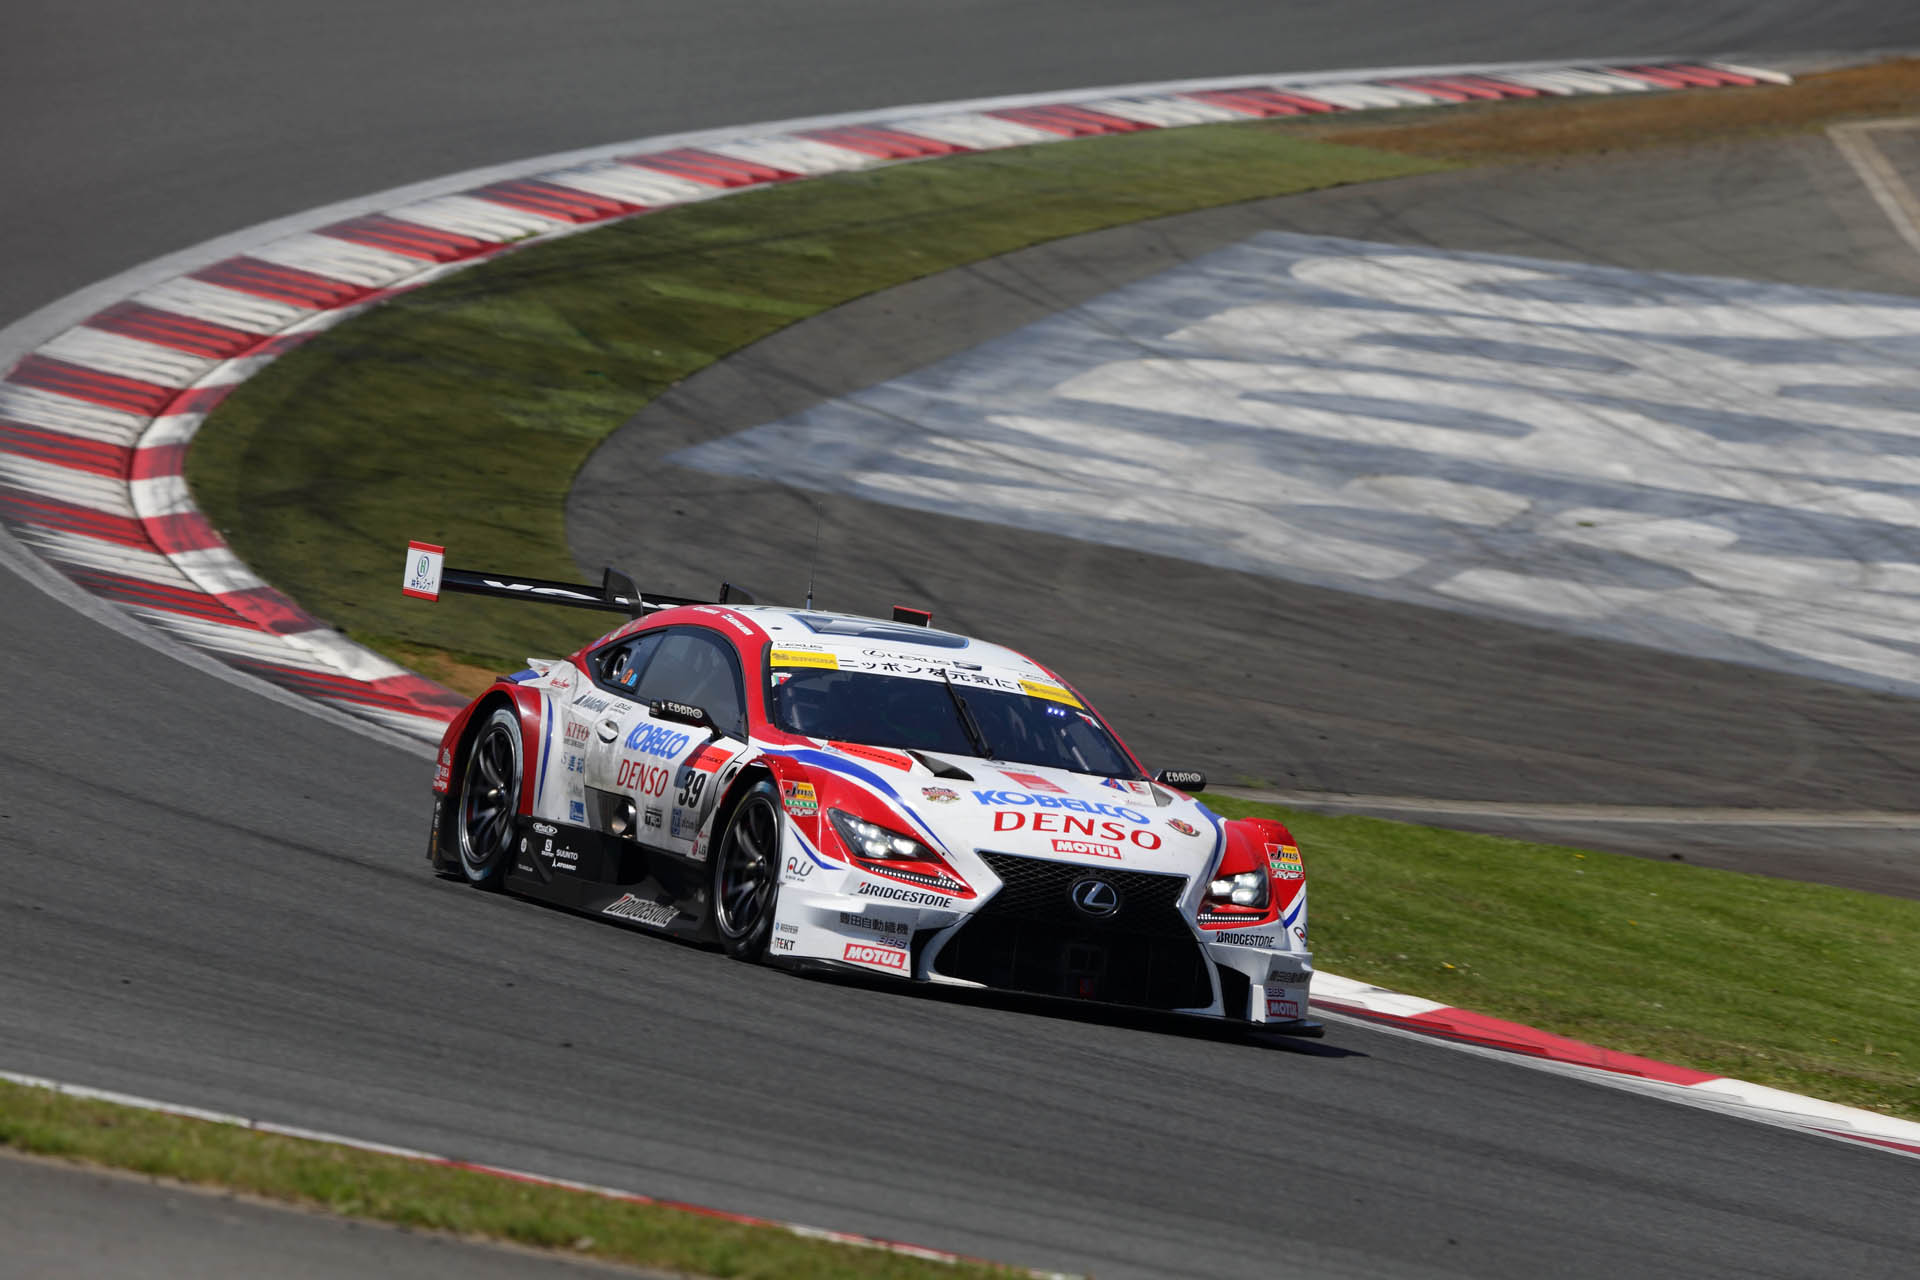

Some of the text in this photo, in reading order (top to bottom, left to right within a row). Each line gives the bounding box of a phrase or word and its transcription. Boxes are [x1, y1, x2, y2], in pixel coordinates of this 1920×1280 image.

[667, 701, 703, 719] EBBRO
[624, 721, 690, 760] KOBELCO
[616, 758, 669, 798] DENSO
[678, 770, 707, 809] 39
[1166, 771, 1201, 783] EBBRO
[971, 789, 1151, 825] KOBELCO
[993, 811, 1162, 850] DENSO
[1056, 841, 1120, 858] MOTUL
[857, 881, 953, 908] BRIDGESTONE
[608, 895, 678, 926] BRIDGESTONE
[1216, 930, 1275, 948] BRIDGESTONE
[845, 945, 903, 966] MOTUL
